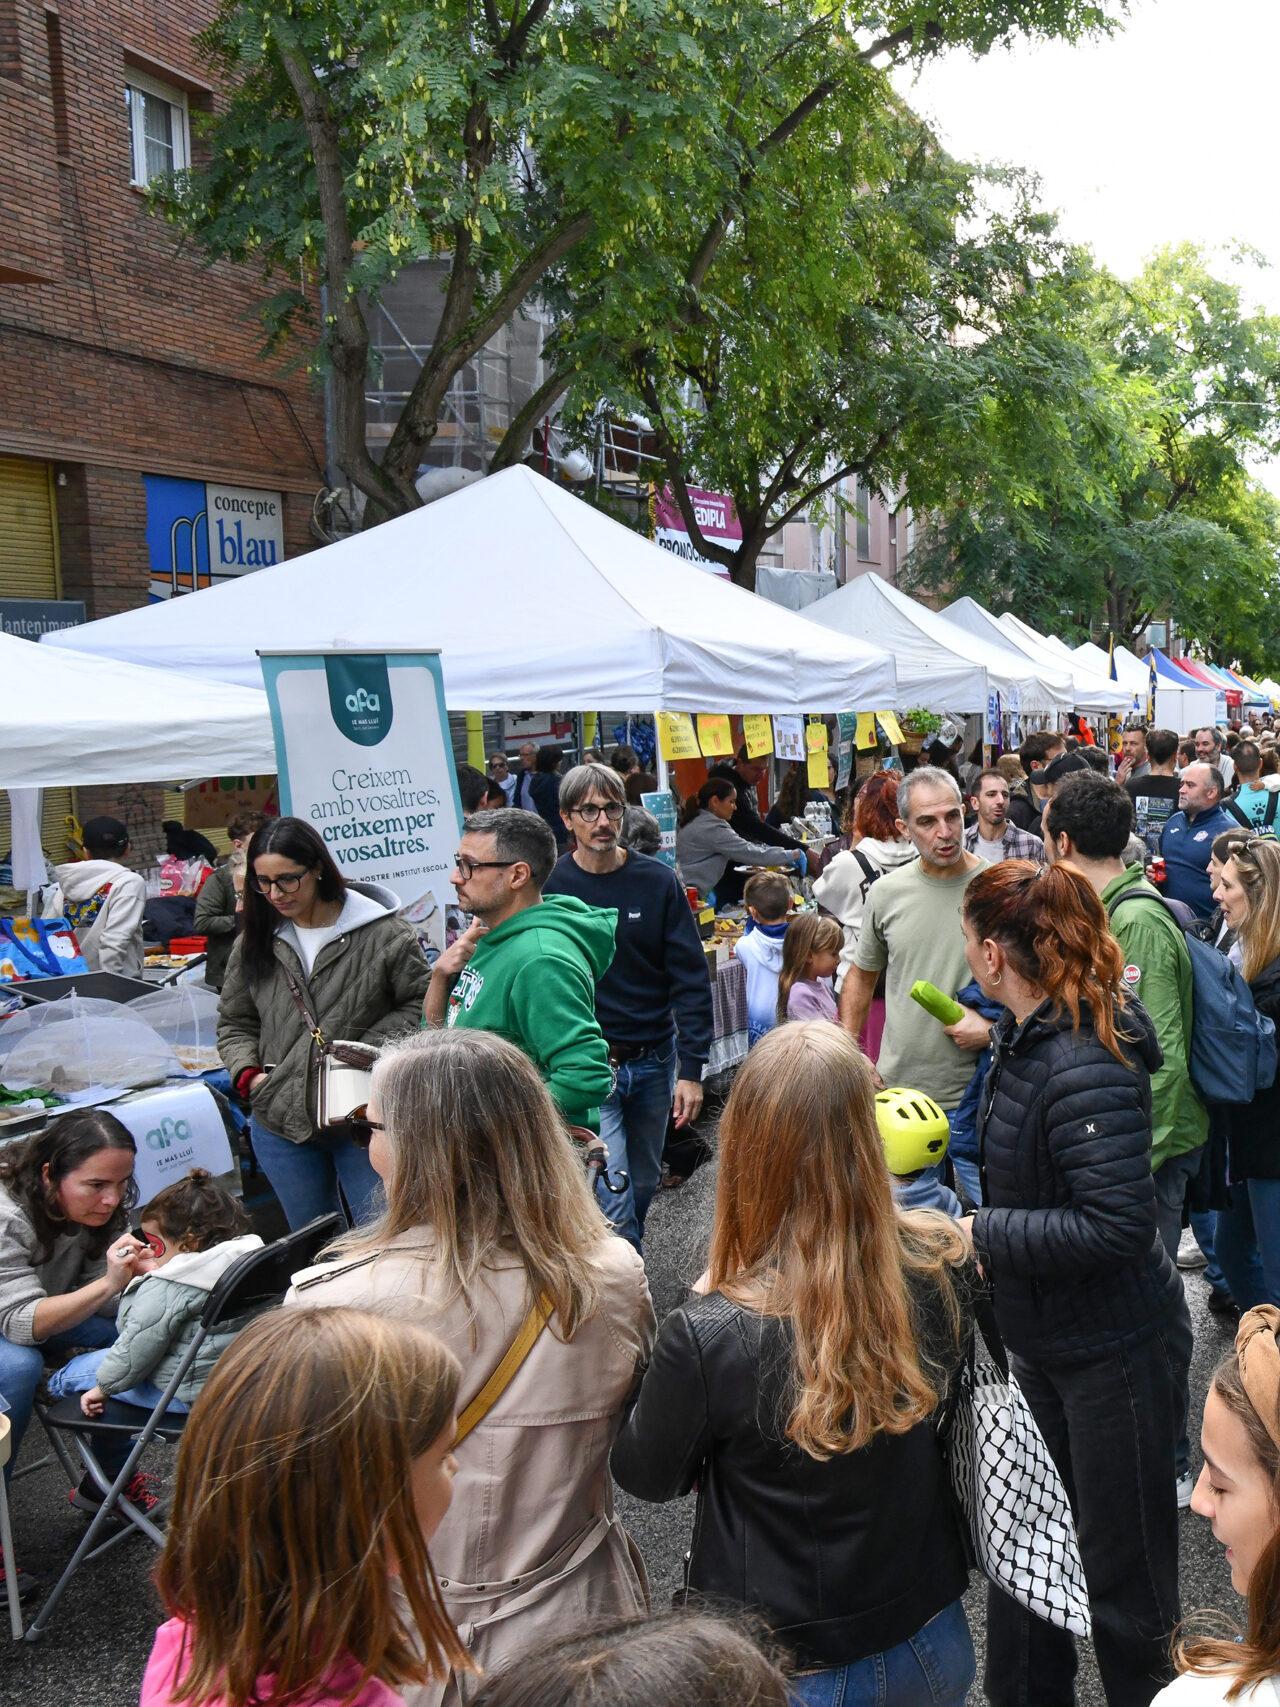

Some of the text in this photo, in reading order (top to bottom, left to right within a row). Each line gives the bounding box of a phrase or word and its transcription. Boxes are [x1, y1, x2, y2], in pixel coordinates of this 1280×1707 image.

[214, 494, 276, 520] concepte
[216, 518, 277, 567] blau
[345, 687, 381, 712] afa
[332, 768, 412, 792] Creixem
[311, 789, 441, 819] amb vosaltres,
[322, 812, 436, 842] creixem per
[336, 837, 430, 864] vosaltres.
[145, 1116, 193, 1150] afa
[165, 1154, 178, 1163] MAS
